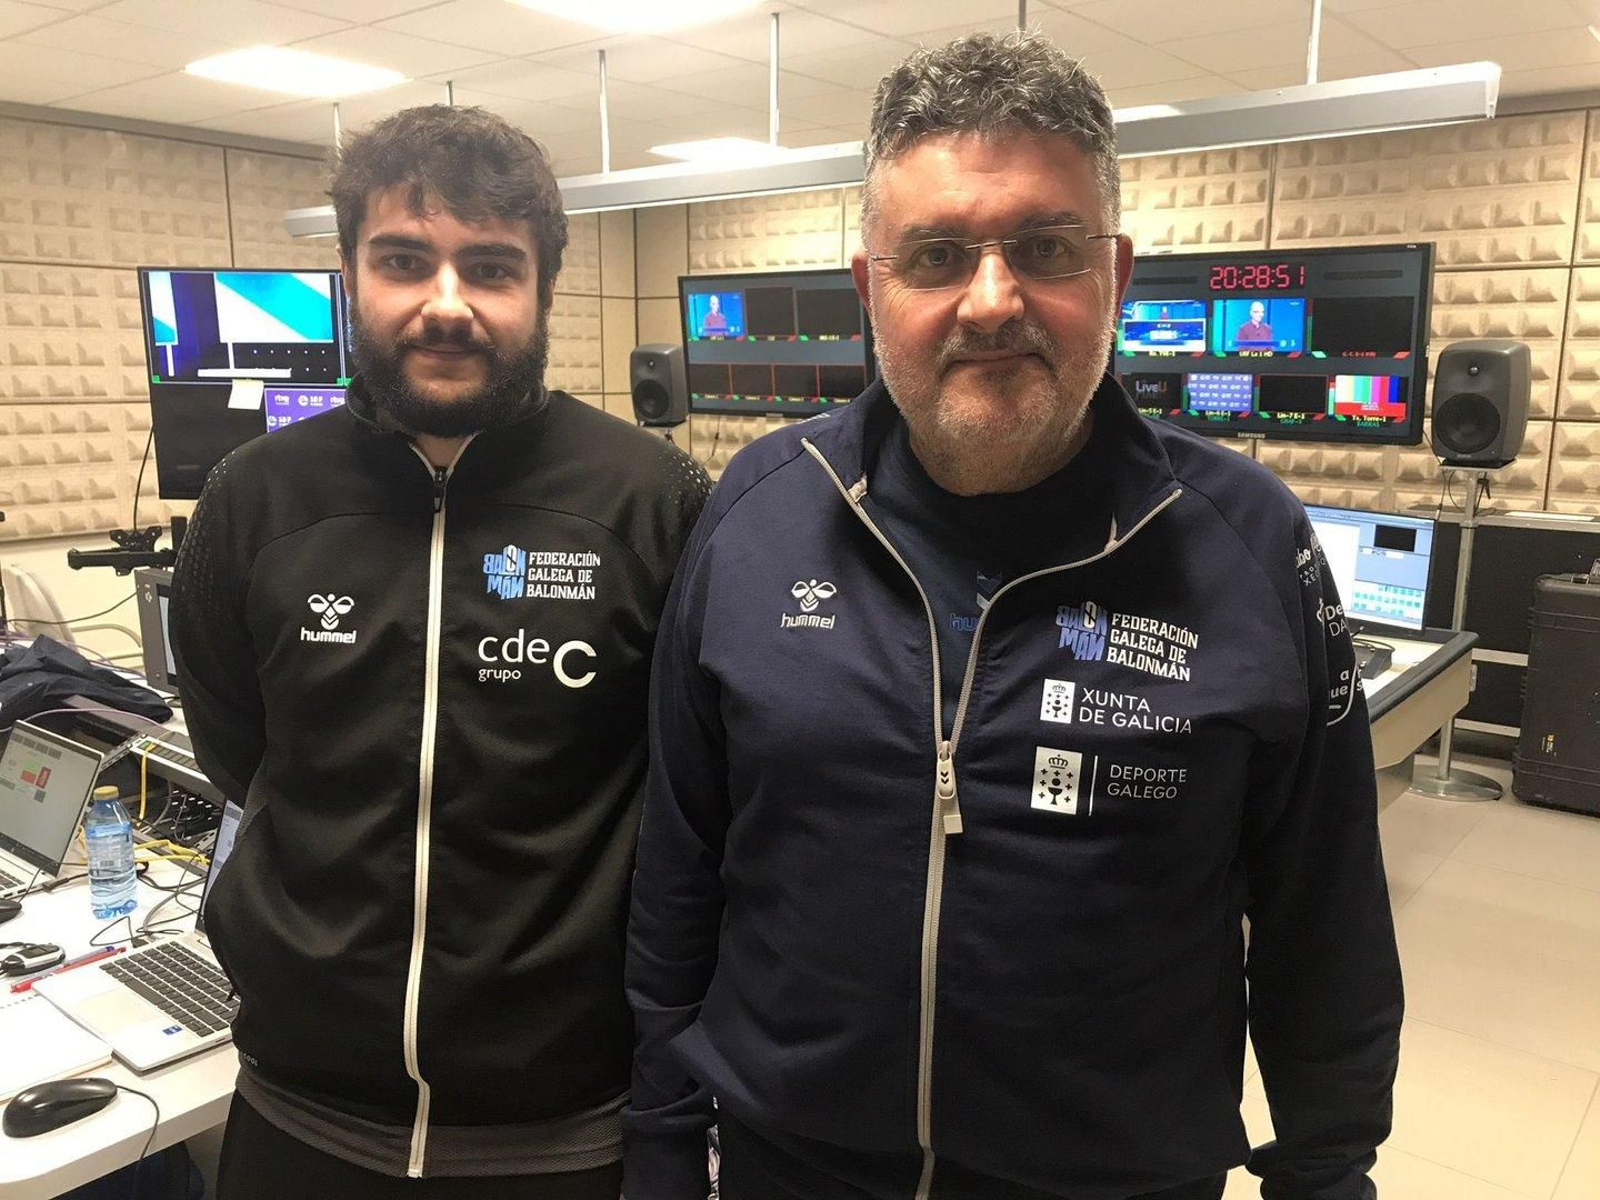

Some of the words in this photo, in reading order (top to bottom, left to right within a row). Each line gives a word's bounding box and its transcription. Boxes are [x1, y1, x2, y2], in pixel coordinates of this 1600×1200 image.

[1210, 265, 1305, 289] 20:28:51
[1135, 380, 1167, 393] LiveU
[528, 551, 601, 567] FEDERACIÓN
[527, 568, 574, 583] GALEGA
[577, 568, 593, 583] DE
[526, 583, 596, 600] BALONMÁN
[780, 613, 836, 630] hummel
[300, 627, 357, 644] hummel
[1112, 612, 1199, 650] FEDERACIÓN
[1110, 628, 1166, 658] GALEGA
[1168, 644, 1187, 664] DE
[1106, 646, 1191, 682] BALONMÁN
[478, 667, 522, 683] grupo
[1081, 687, 1151, 713] XUNTA
[1078, 706, 1105, 725] DE
[1111, 712, 1192, 734] GALICIA
[1109, 764, 1188, 783] DEPORTE
[1107, 782, 1178, 799] GALEGO
